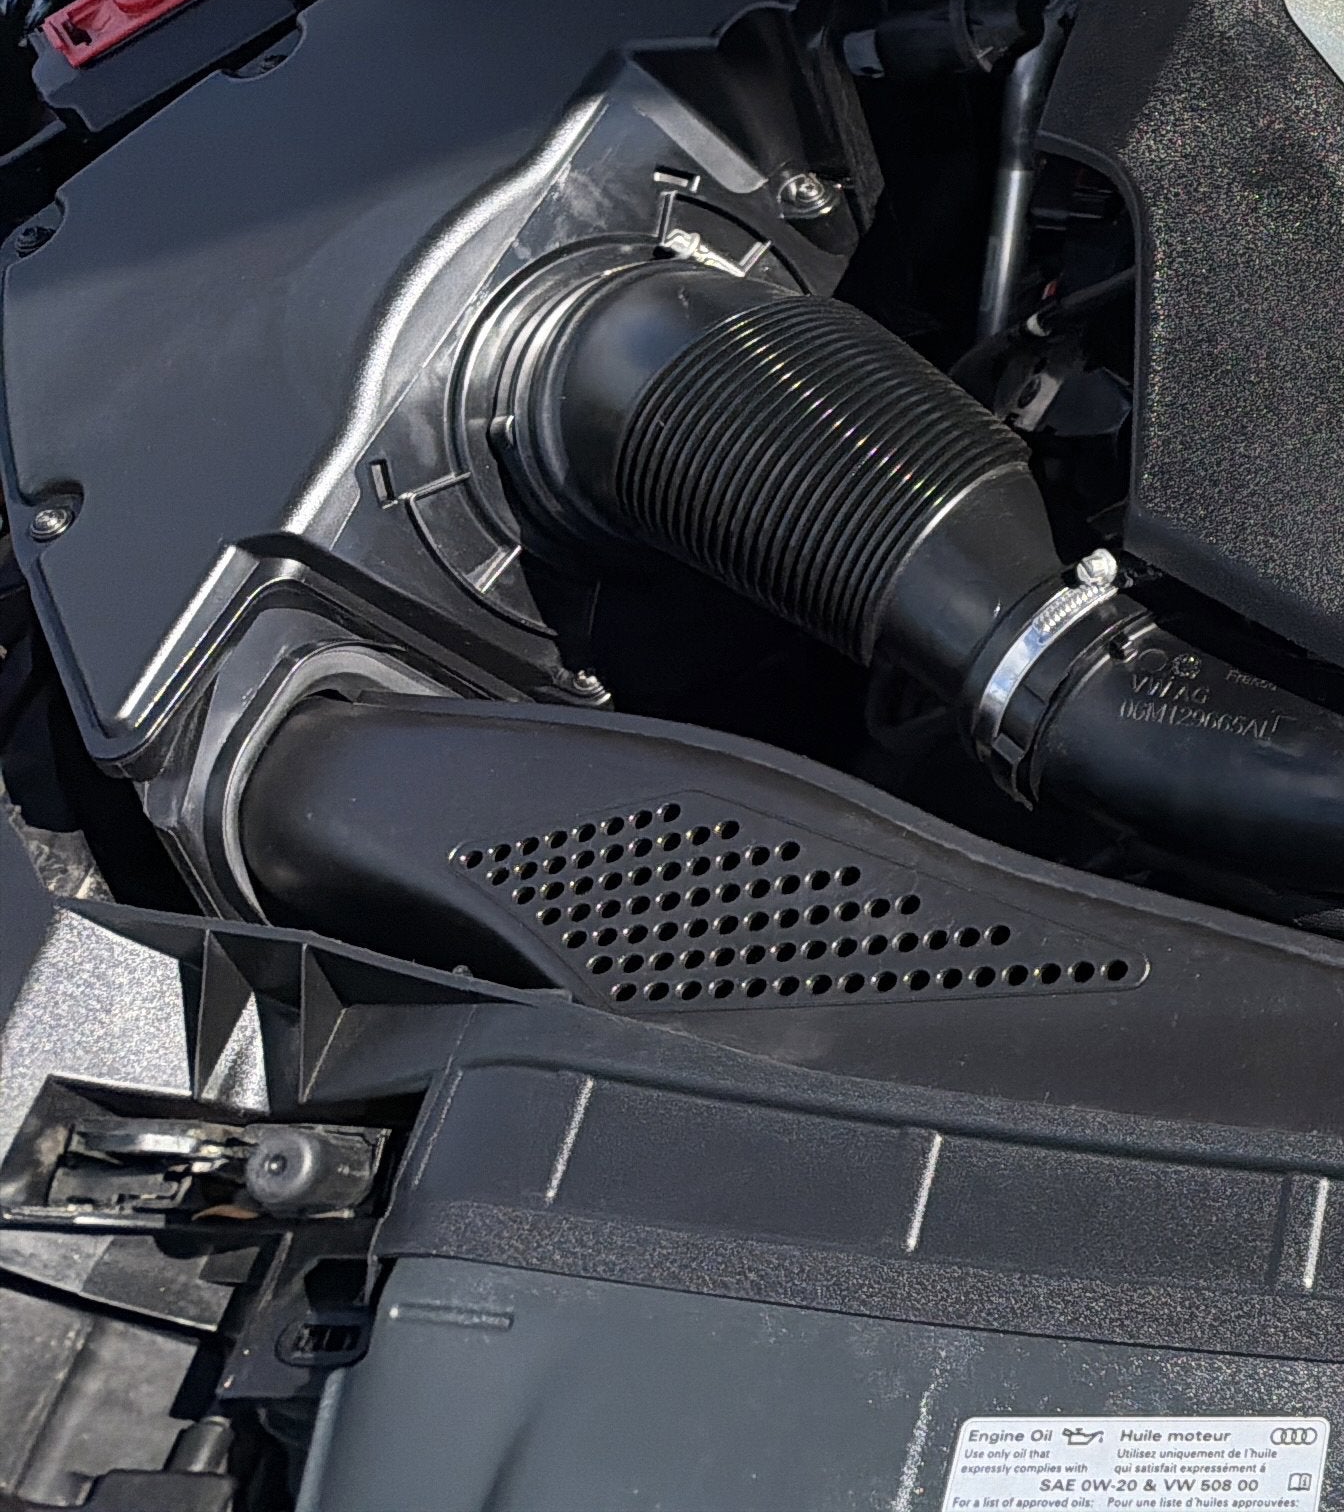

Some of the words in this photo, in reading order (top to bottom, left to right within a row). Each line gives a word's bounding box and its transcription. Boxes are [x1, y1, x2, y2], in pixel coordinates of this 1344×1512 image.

[1131, 673, 1175, 698] VW
[1175, 685, 1209, 704] AG
[968, 1430, 1024, 1444] Engine
[1031, 1430, 1052, 1442] Oil
[1120, 1430, 1162, 1442] Huile
[1168, 1431, 1231, 1442] moteur
[964, 1449, 984, 1458] Use
[987, 1449, 1009, 1460] only
[1013, 1449, 1026, 1458] oil
[1029, 1449, 1050, 1458] that
[1117, 1448, 1156, 1458] Utilisez
[1159, 1449, 1225, 1460] uniquement
[1228, 1448, 1241, 1458] de
[961, 1464, 1011, 1475] expressly
[1013, 1464, 1062, 1475] complies
[1065, 1464, 1088, 1473] with
[1114, 1463, 1132, 1475] qui
[1135, 1463, 1177, 1473] satisfait
[1039, 1479, 1076, 1491] SAE
[1080, 1479, 1138, 1492] 0W-20
[1143, 1480, 1157, 1491] &
[1164, 1479, 1196, 1491] VW
[1200, 1479, 1232, 1491] 508
[1237, 1480, 1258, 1492] 00
[952, 1497, 970, 1507] For
[983, 1497, 999, 1507] list
[1002, 1496, 1014, 1507] of
[1018, 1497, 1068, 1509] approved
[1107, 1497, 1133, 1507] Pour
[1136, 1499, 1156, 1507] une
[1160, 1497, 1182, 1507] liste
